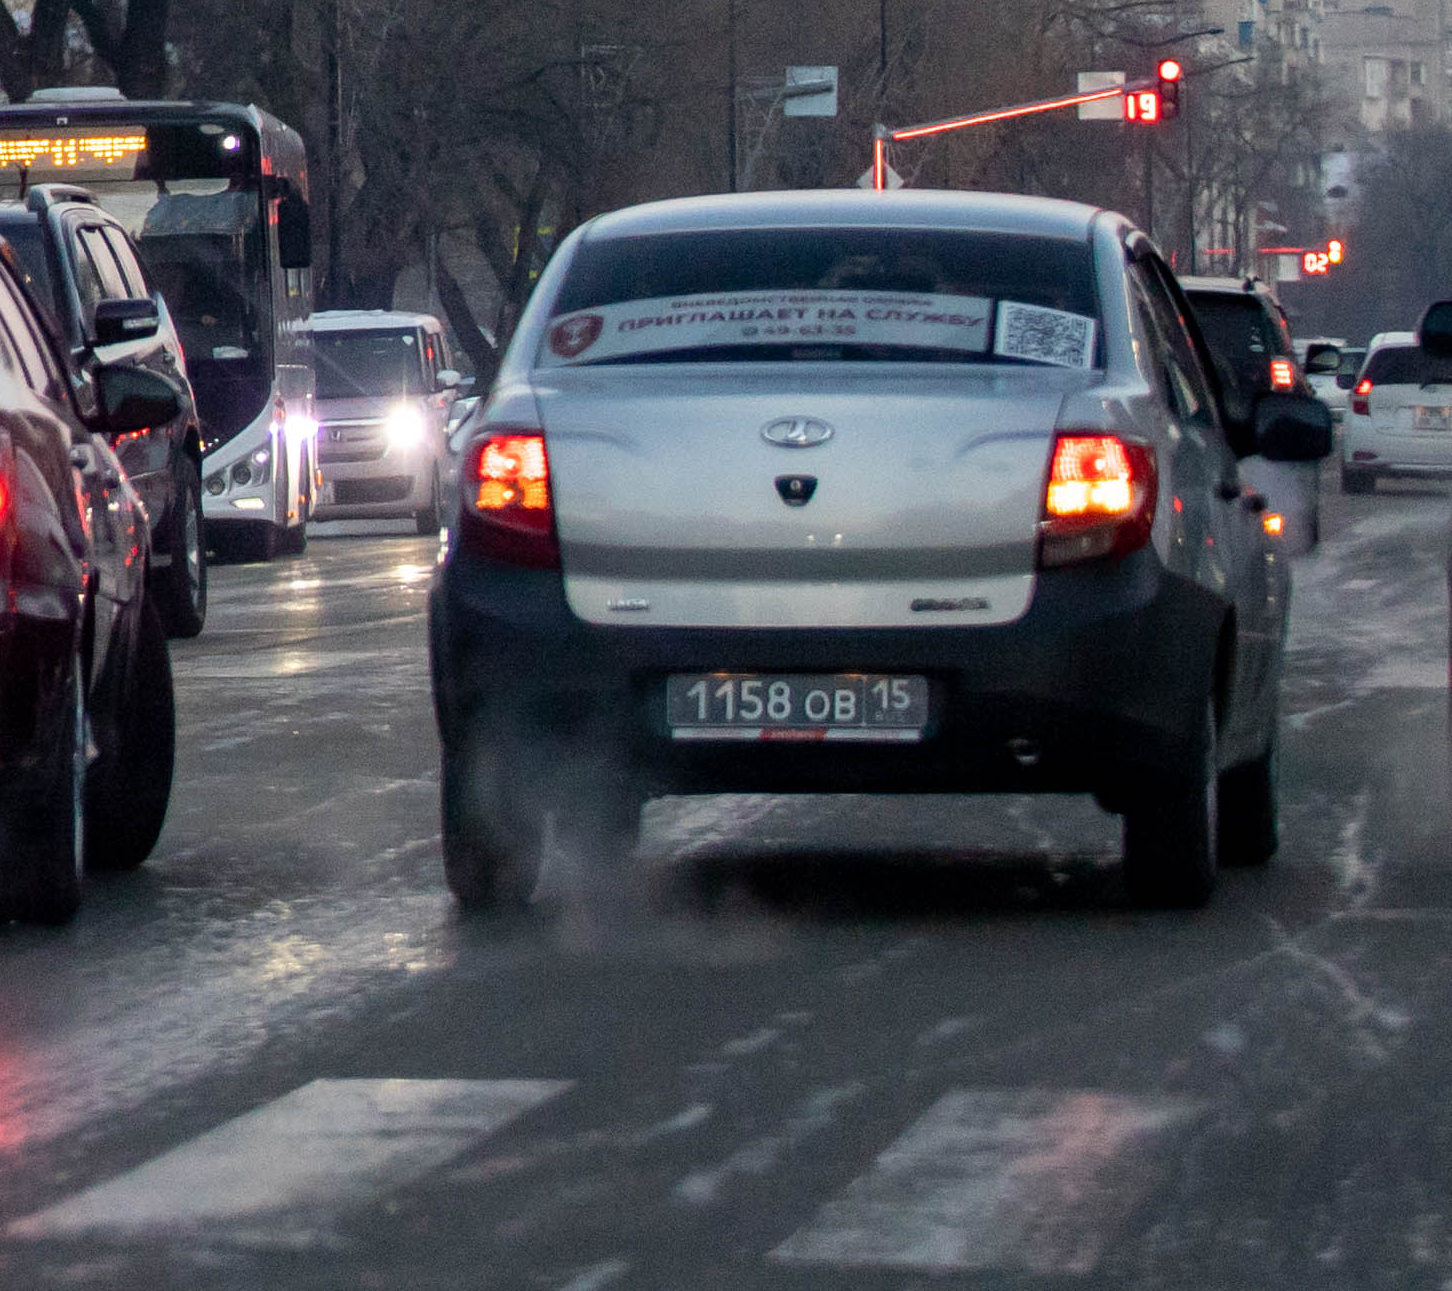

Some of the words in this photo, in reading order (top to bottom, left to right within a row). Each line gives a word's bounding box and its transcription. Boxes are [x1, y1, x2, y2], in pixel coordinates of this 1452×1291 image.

[1126, 92, 1157, 120] 19
[1303, 252, 1330, 274] 02
[617, 307, 808, 332] ПРИГЛАШАЕТ
[817, 308, 856, 320] НА
[865, 307, 985, 327] СЛУЖБУ
[871, 679, 910, 709] 15
